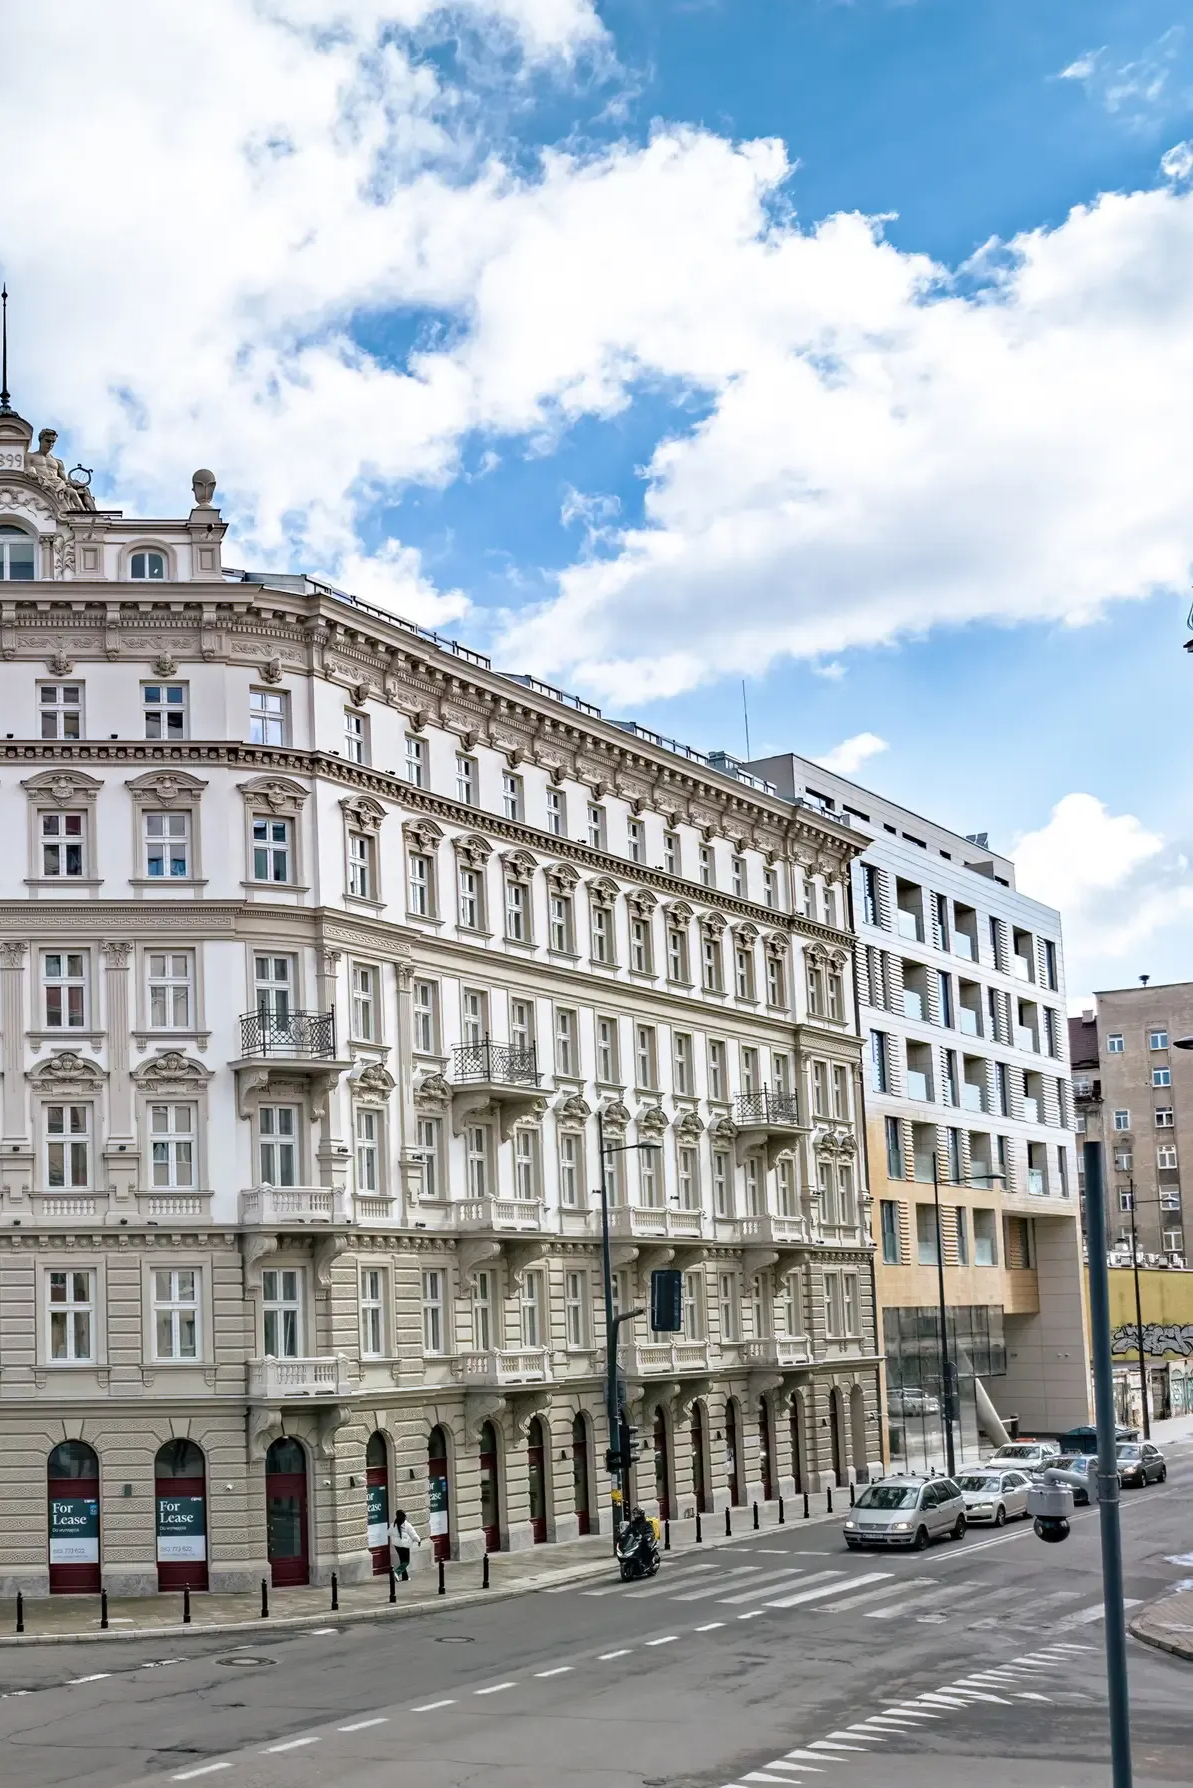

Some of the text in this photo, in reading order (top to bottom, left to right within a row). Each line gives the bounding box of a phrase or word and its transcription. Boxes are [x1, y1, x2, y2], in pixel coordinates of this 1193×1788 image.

[52, 1502, 74, 1513] For
[159, 1501, 181, 1512] For
[367, 1503, 382, 1512] ease
[52, 1514, 87, 1525] Lease
[159, 1512, 194, 1523] Lease
